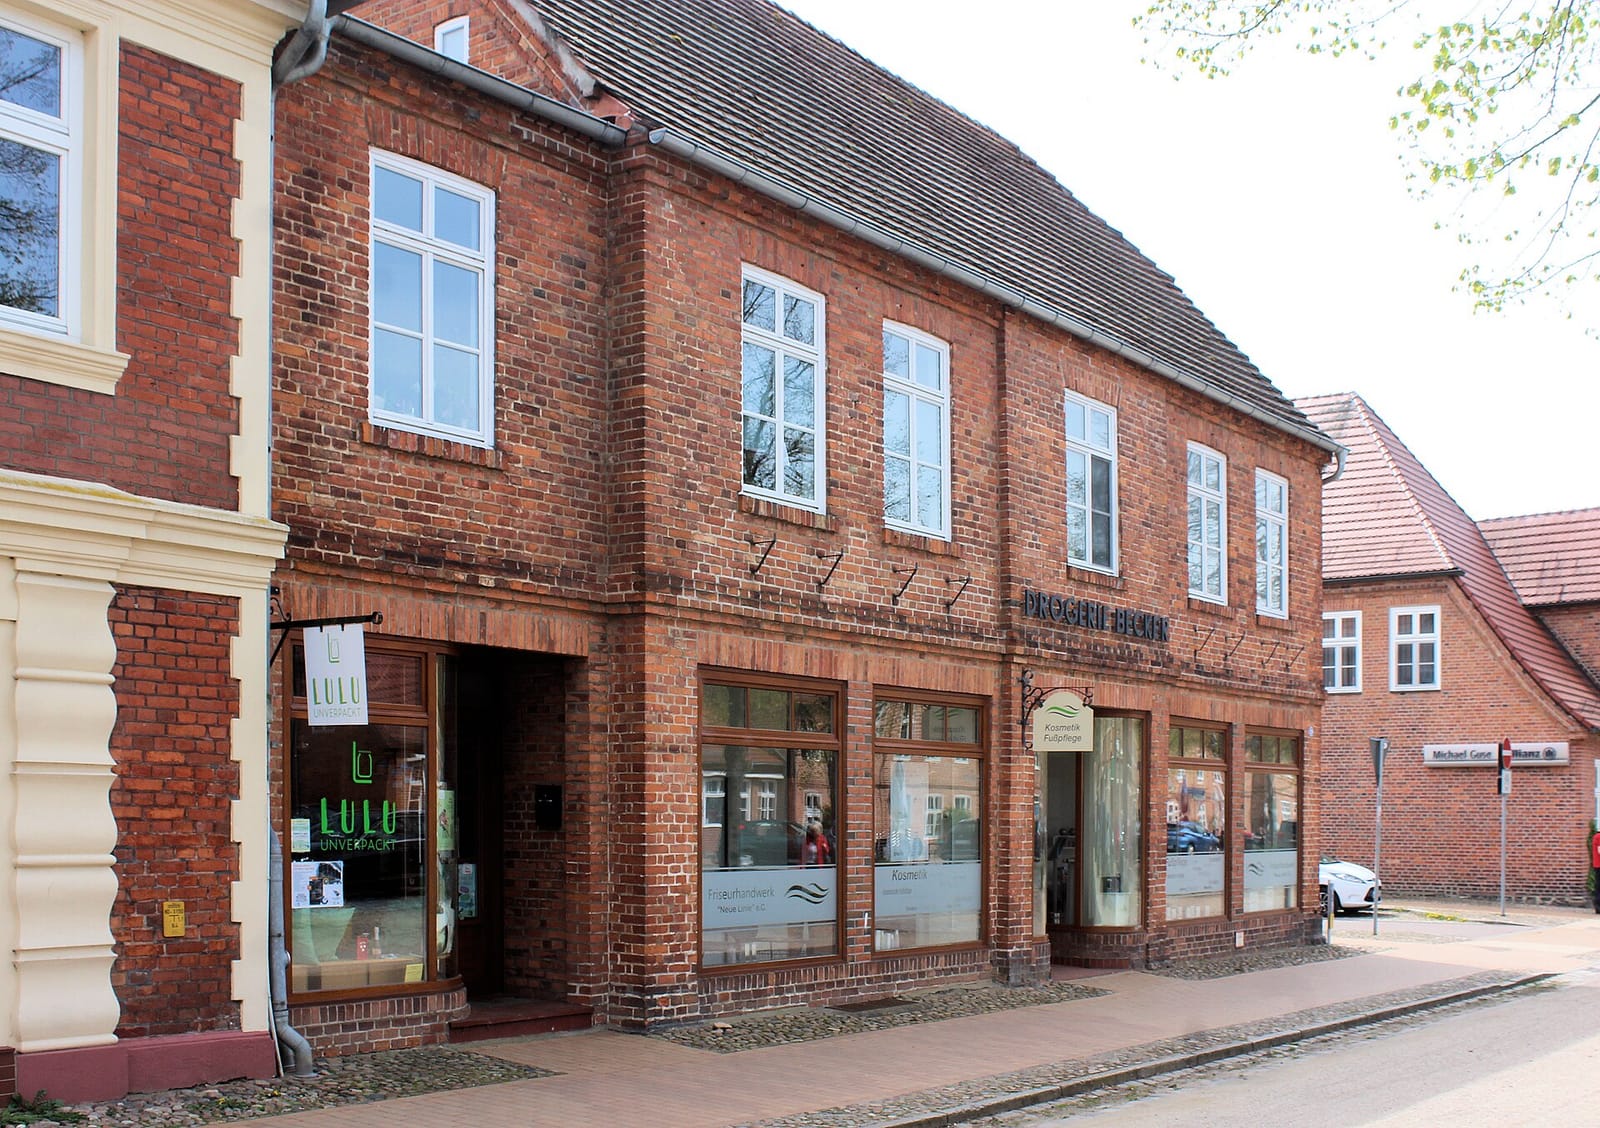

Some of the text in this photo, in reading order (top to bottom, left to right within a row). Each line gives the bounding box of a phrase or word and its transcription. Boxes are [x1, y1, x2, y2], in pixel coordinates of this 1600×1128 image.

[1024, 589, 1170, 641] DROGERIE BECKER
[312, 676, 360, 705] LULU
[313, 708, 361, 718] UNVERPACKT
[1045, 723, 1081, 732] Kosmetik
[1044, 734, 1082, 744] Fußpflege
[1433, 750, 1468, 759] Michael
[1511, 749, 1541, 759] llianz
[320, 797, 396, 834] LULU
[320, 839, 396, 851] UNVERPACKT
[891, 868, 928, 881] Kosmetik
[708, 887, 776, 900] Friseurhandwerk
